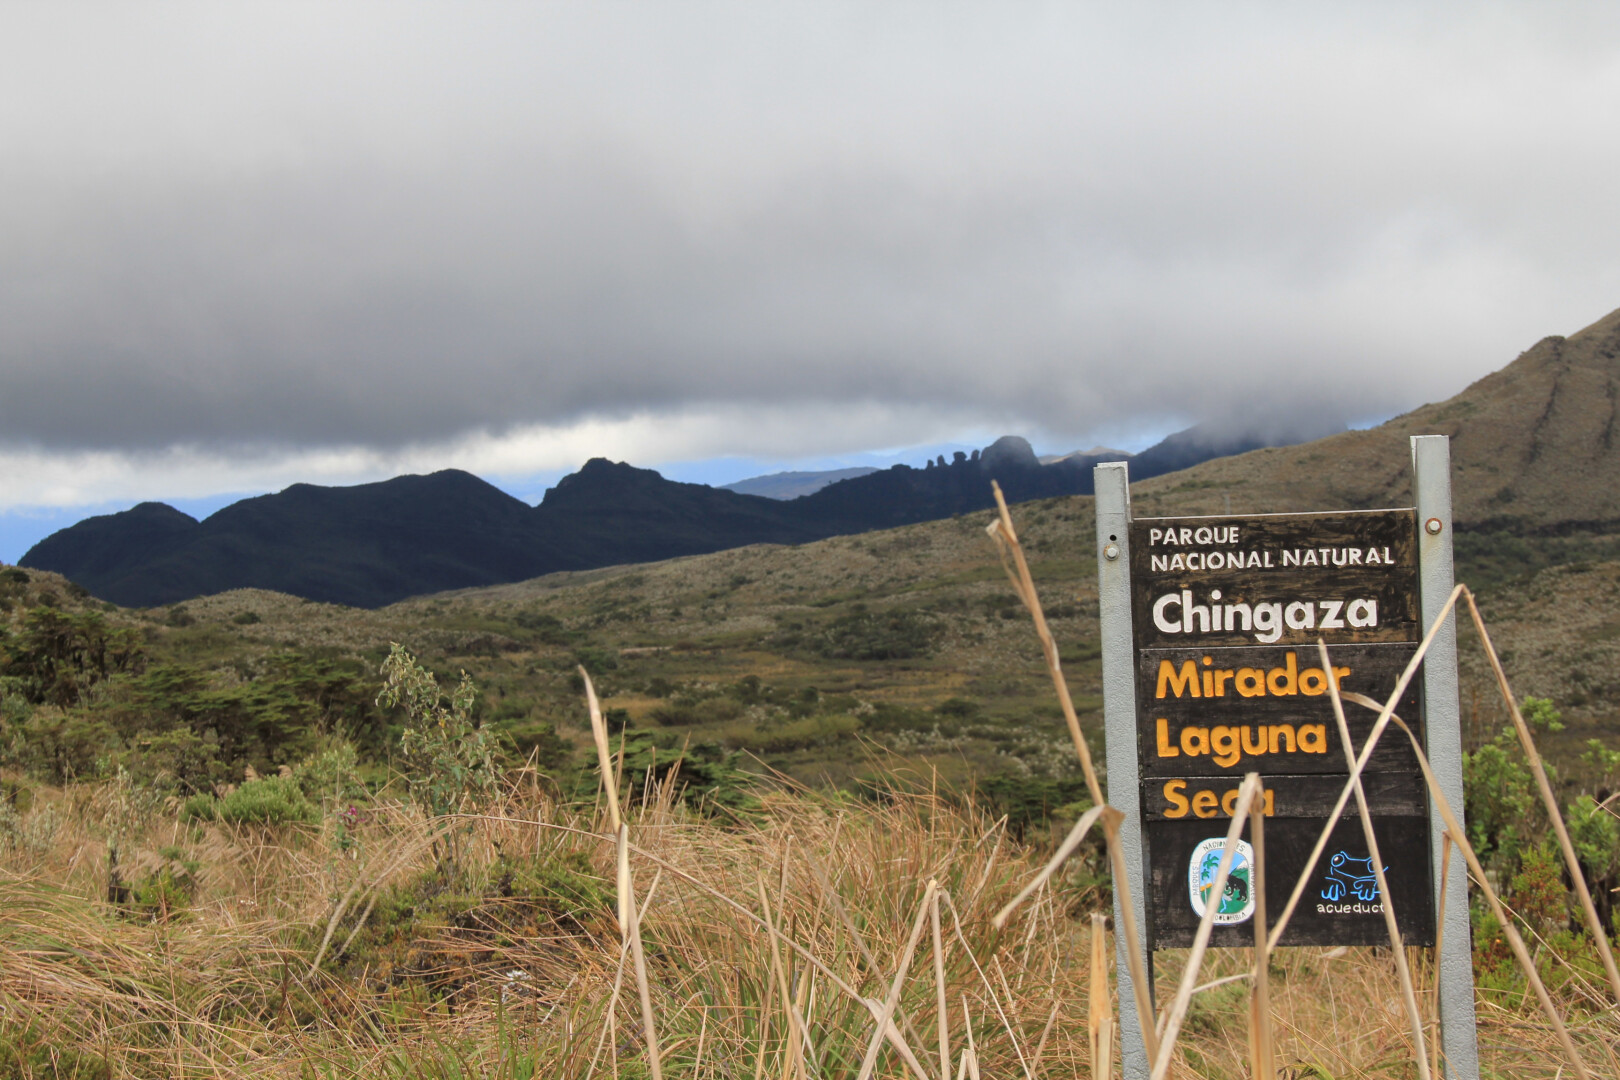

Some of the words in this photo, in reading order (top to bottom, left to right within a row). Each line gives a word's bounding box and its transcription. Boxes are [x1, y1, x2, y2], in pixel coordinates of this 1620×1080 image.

[1150, 526, 1239, 546] PARQUE
[1151, 551, 1274, 572] NACIONAL
[1282, 547, 1395, 568] NATURAL
[1152, 589, 1378, 643] Chingaza
[1155, 652, 1351, 699] Mirador
[1156, 718, 1327, 768] Laguna
[1316, 903, 1385, 914] acueduct
